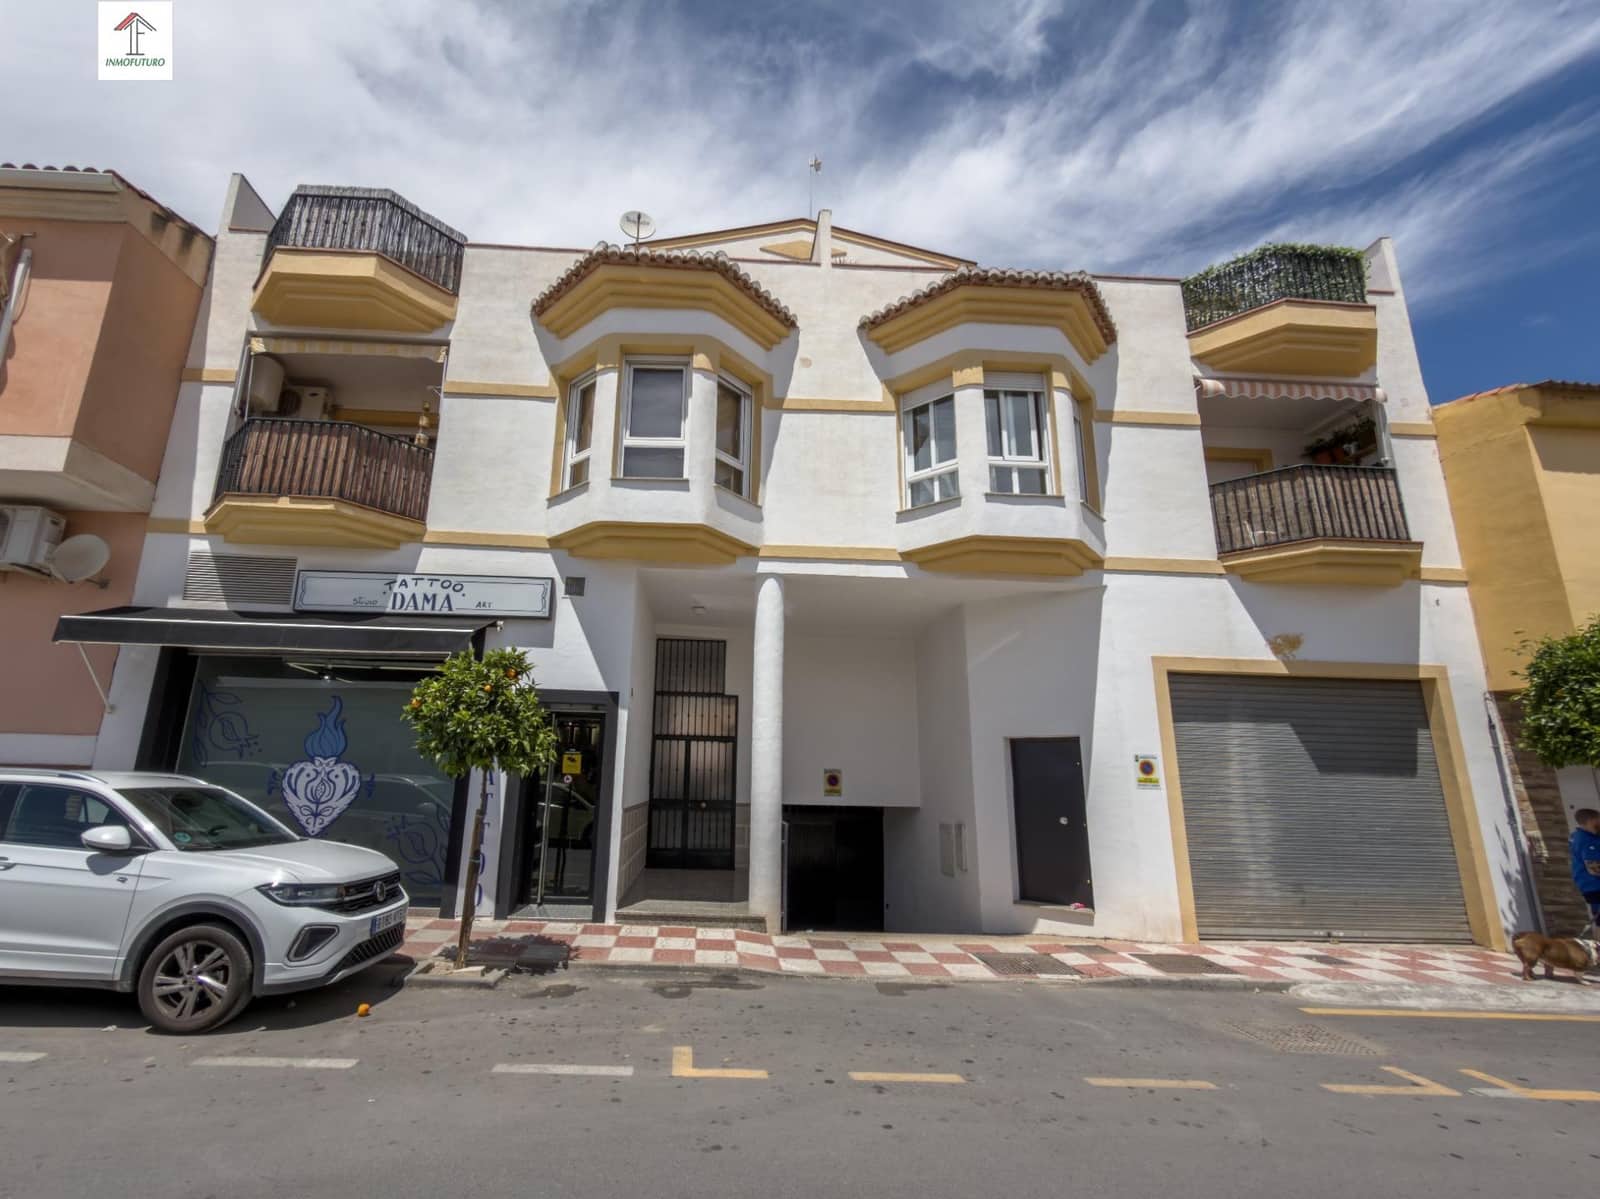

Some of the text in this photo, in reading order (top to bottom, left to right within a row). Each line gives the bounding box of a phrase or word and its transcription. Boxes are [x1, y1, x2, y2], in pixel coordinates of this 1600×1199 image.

[384, 577, 464, 593] TATTOO
[391, 592, 453, 611] DAMA
[475, 600, 493, 609] ART
